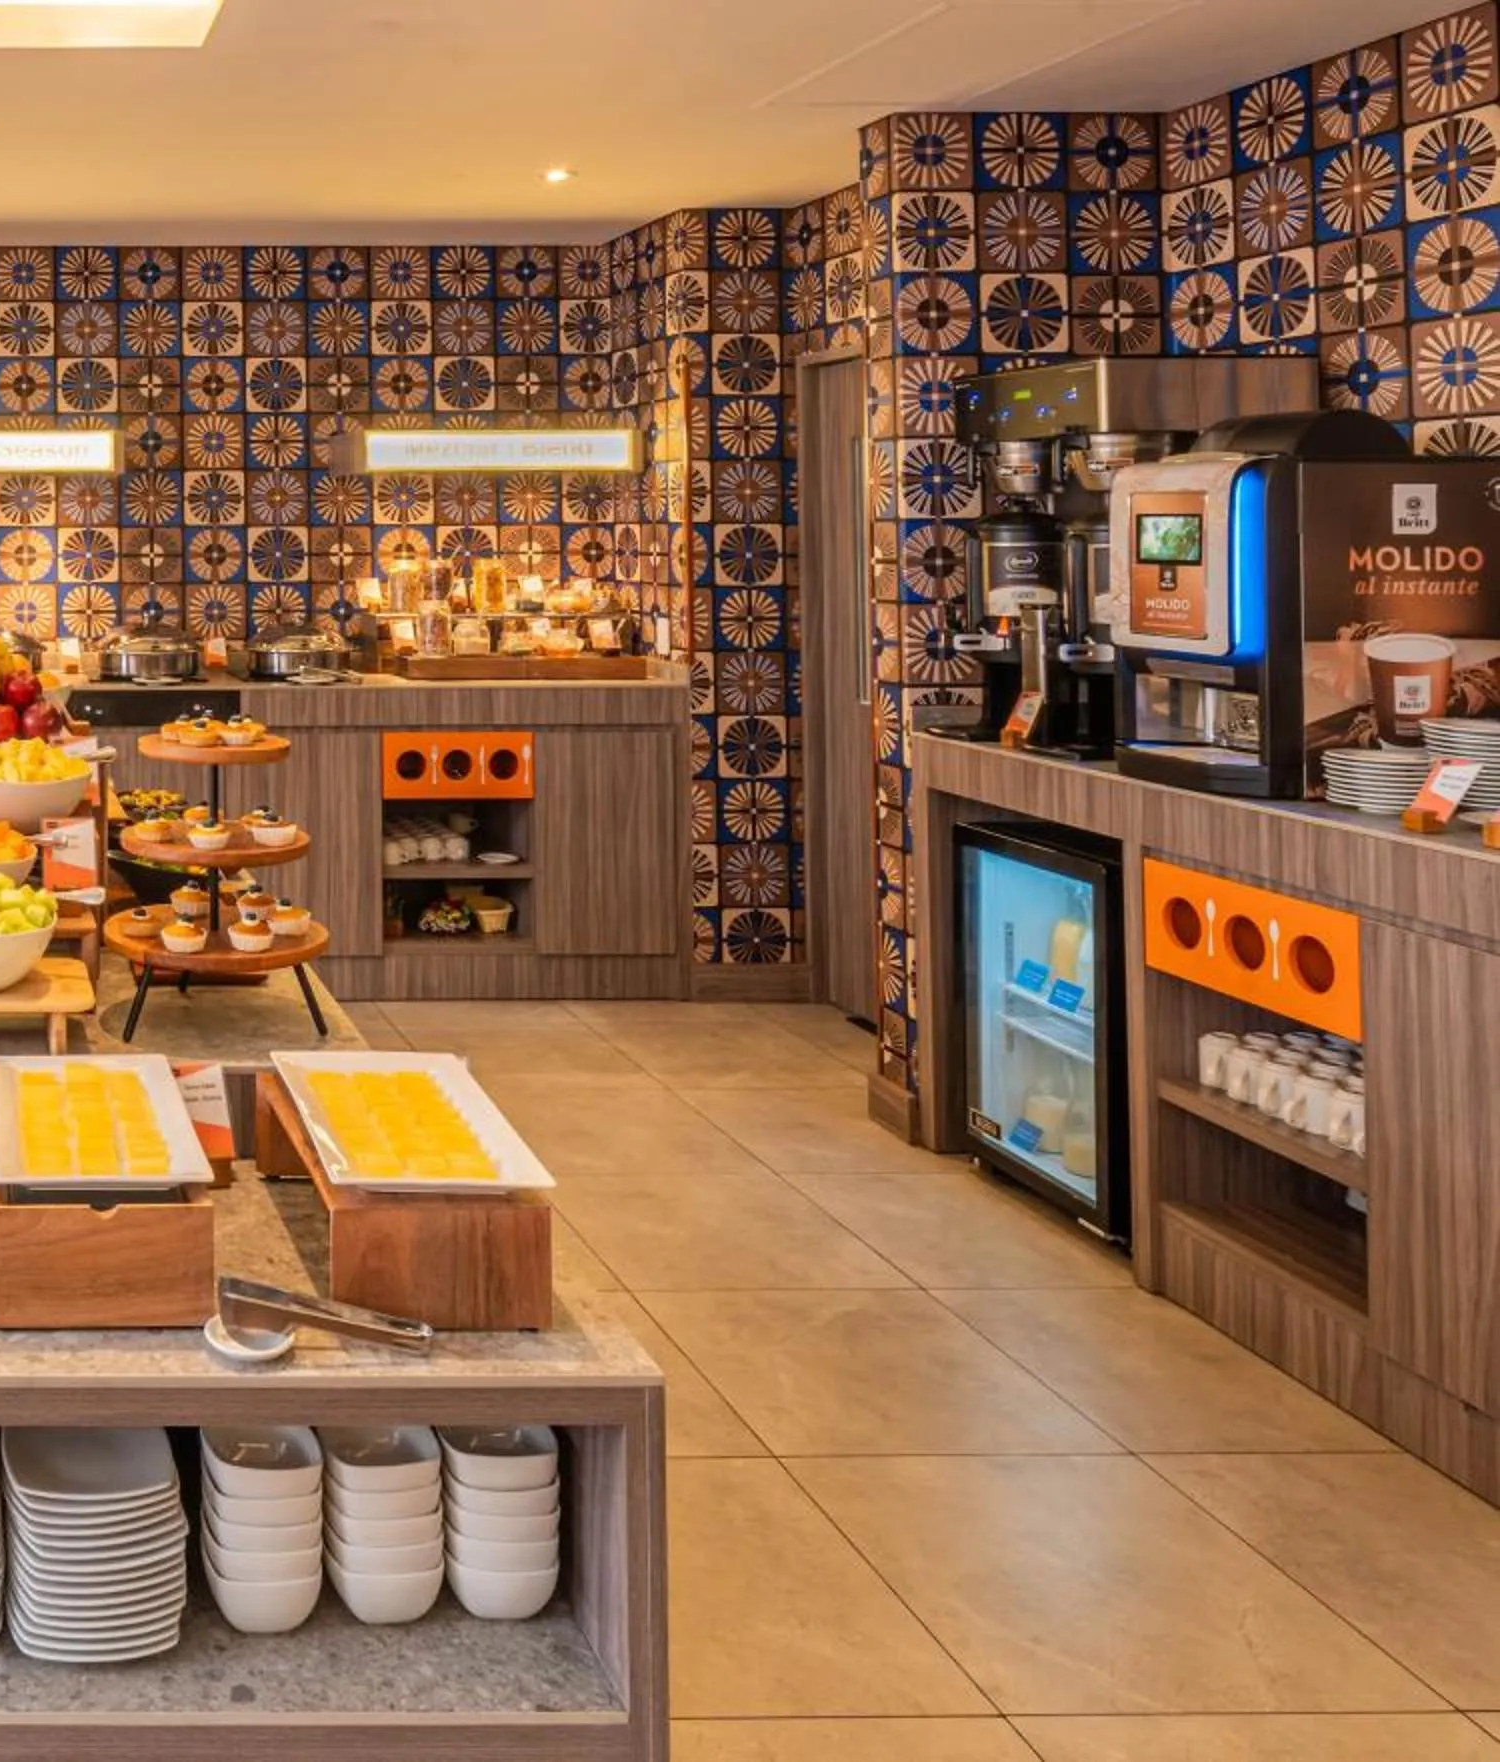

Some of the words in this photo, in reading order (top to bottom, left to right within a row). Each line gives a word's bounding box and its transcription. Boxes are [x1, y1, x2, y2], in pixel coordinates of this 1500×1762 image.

[1348, 545, 1485, 573] MOLIDO
[1355, 576, 1375, 595] al
[1382, 575, 1480, 596] instante
